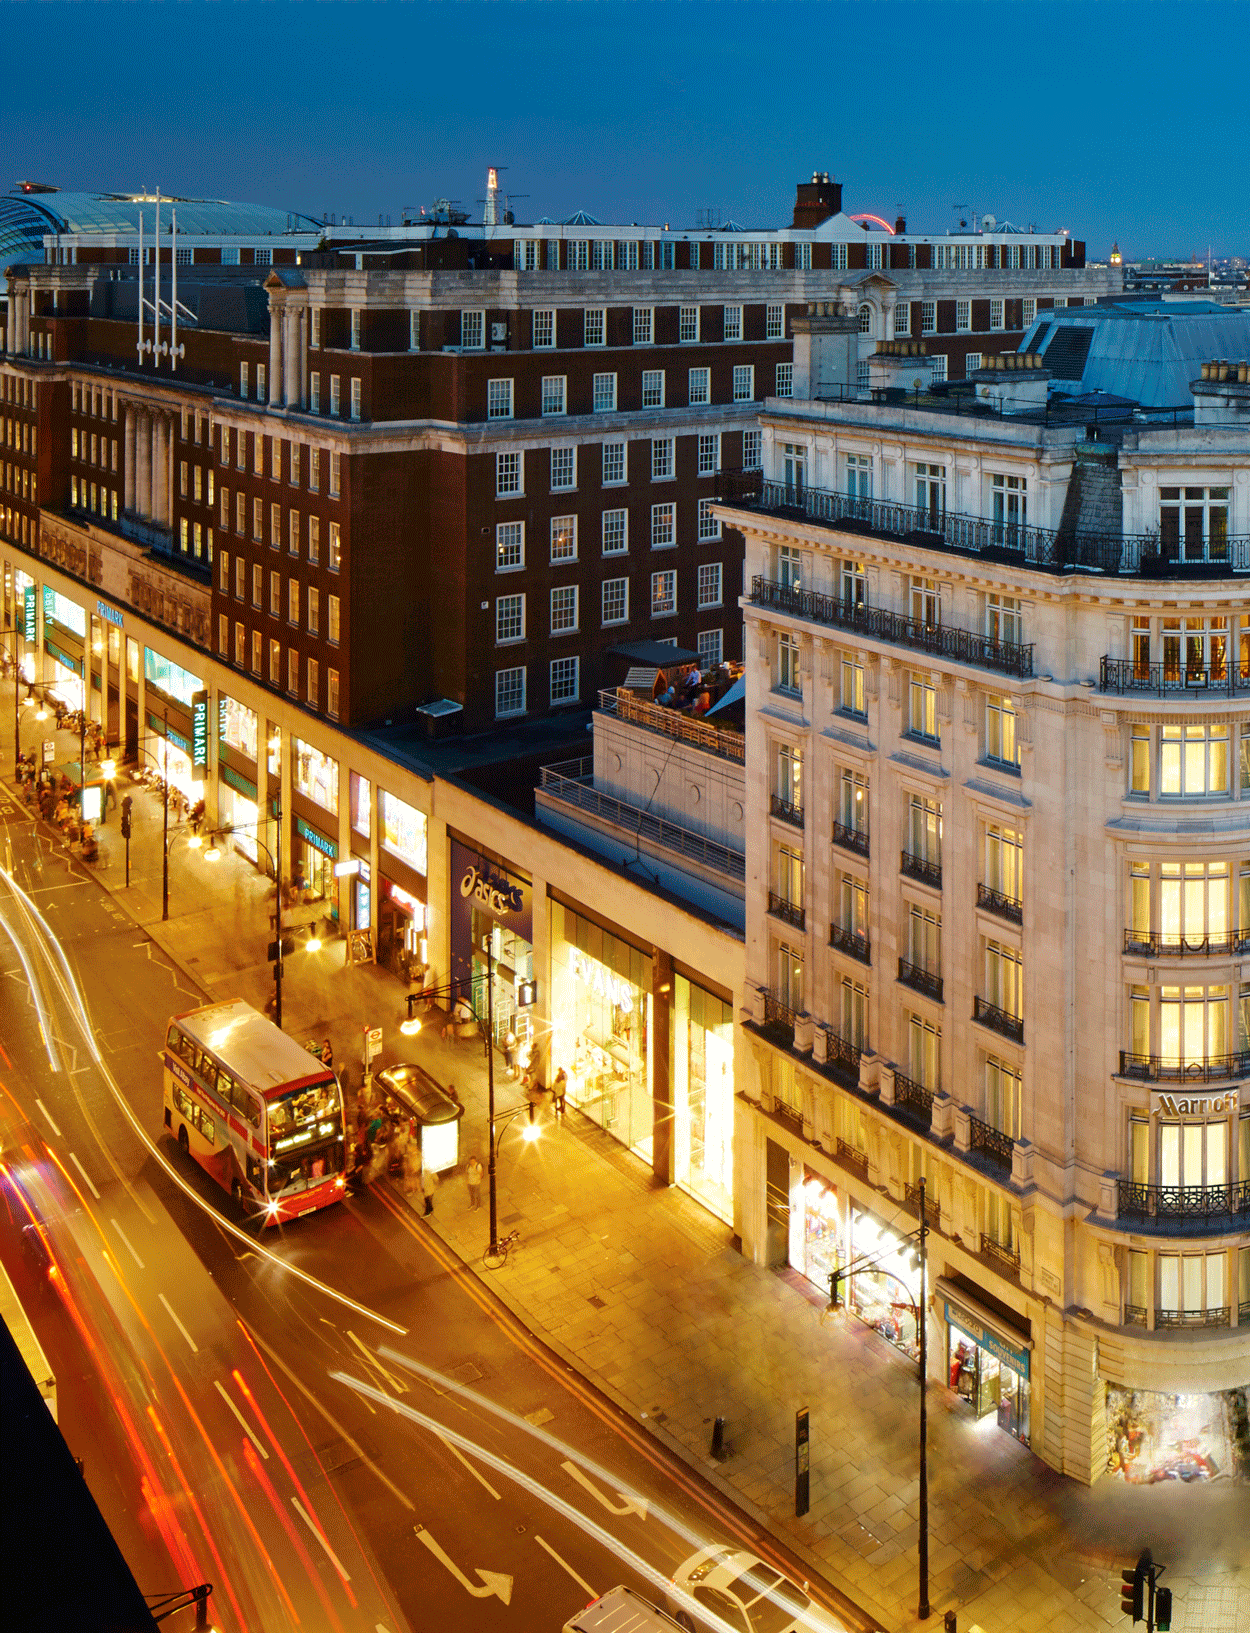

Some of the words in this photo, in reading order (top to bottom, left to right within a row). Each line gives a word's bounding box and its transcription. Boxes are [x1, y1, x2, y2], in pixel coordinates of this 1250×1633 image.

[25, 594, 36, 642] PRIMARK
[97, 600, 124, 628] PRIMARK
[194, 703, 206, 766] PRIMARK
[305, 828, 335, 858] PRIMARK
[569, 947, 633, 1013] EVANS
[1152, 1090, 1239, 1116] Marriott
[988, 1340, 1026, 1373] SOUVENIRS
